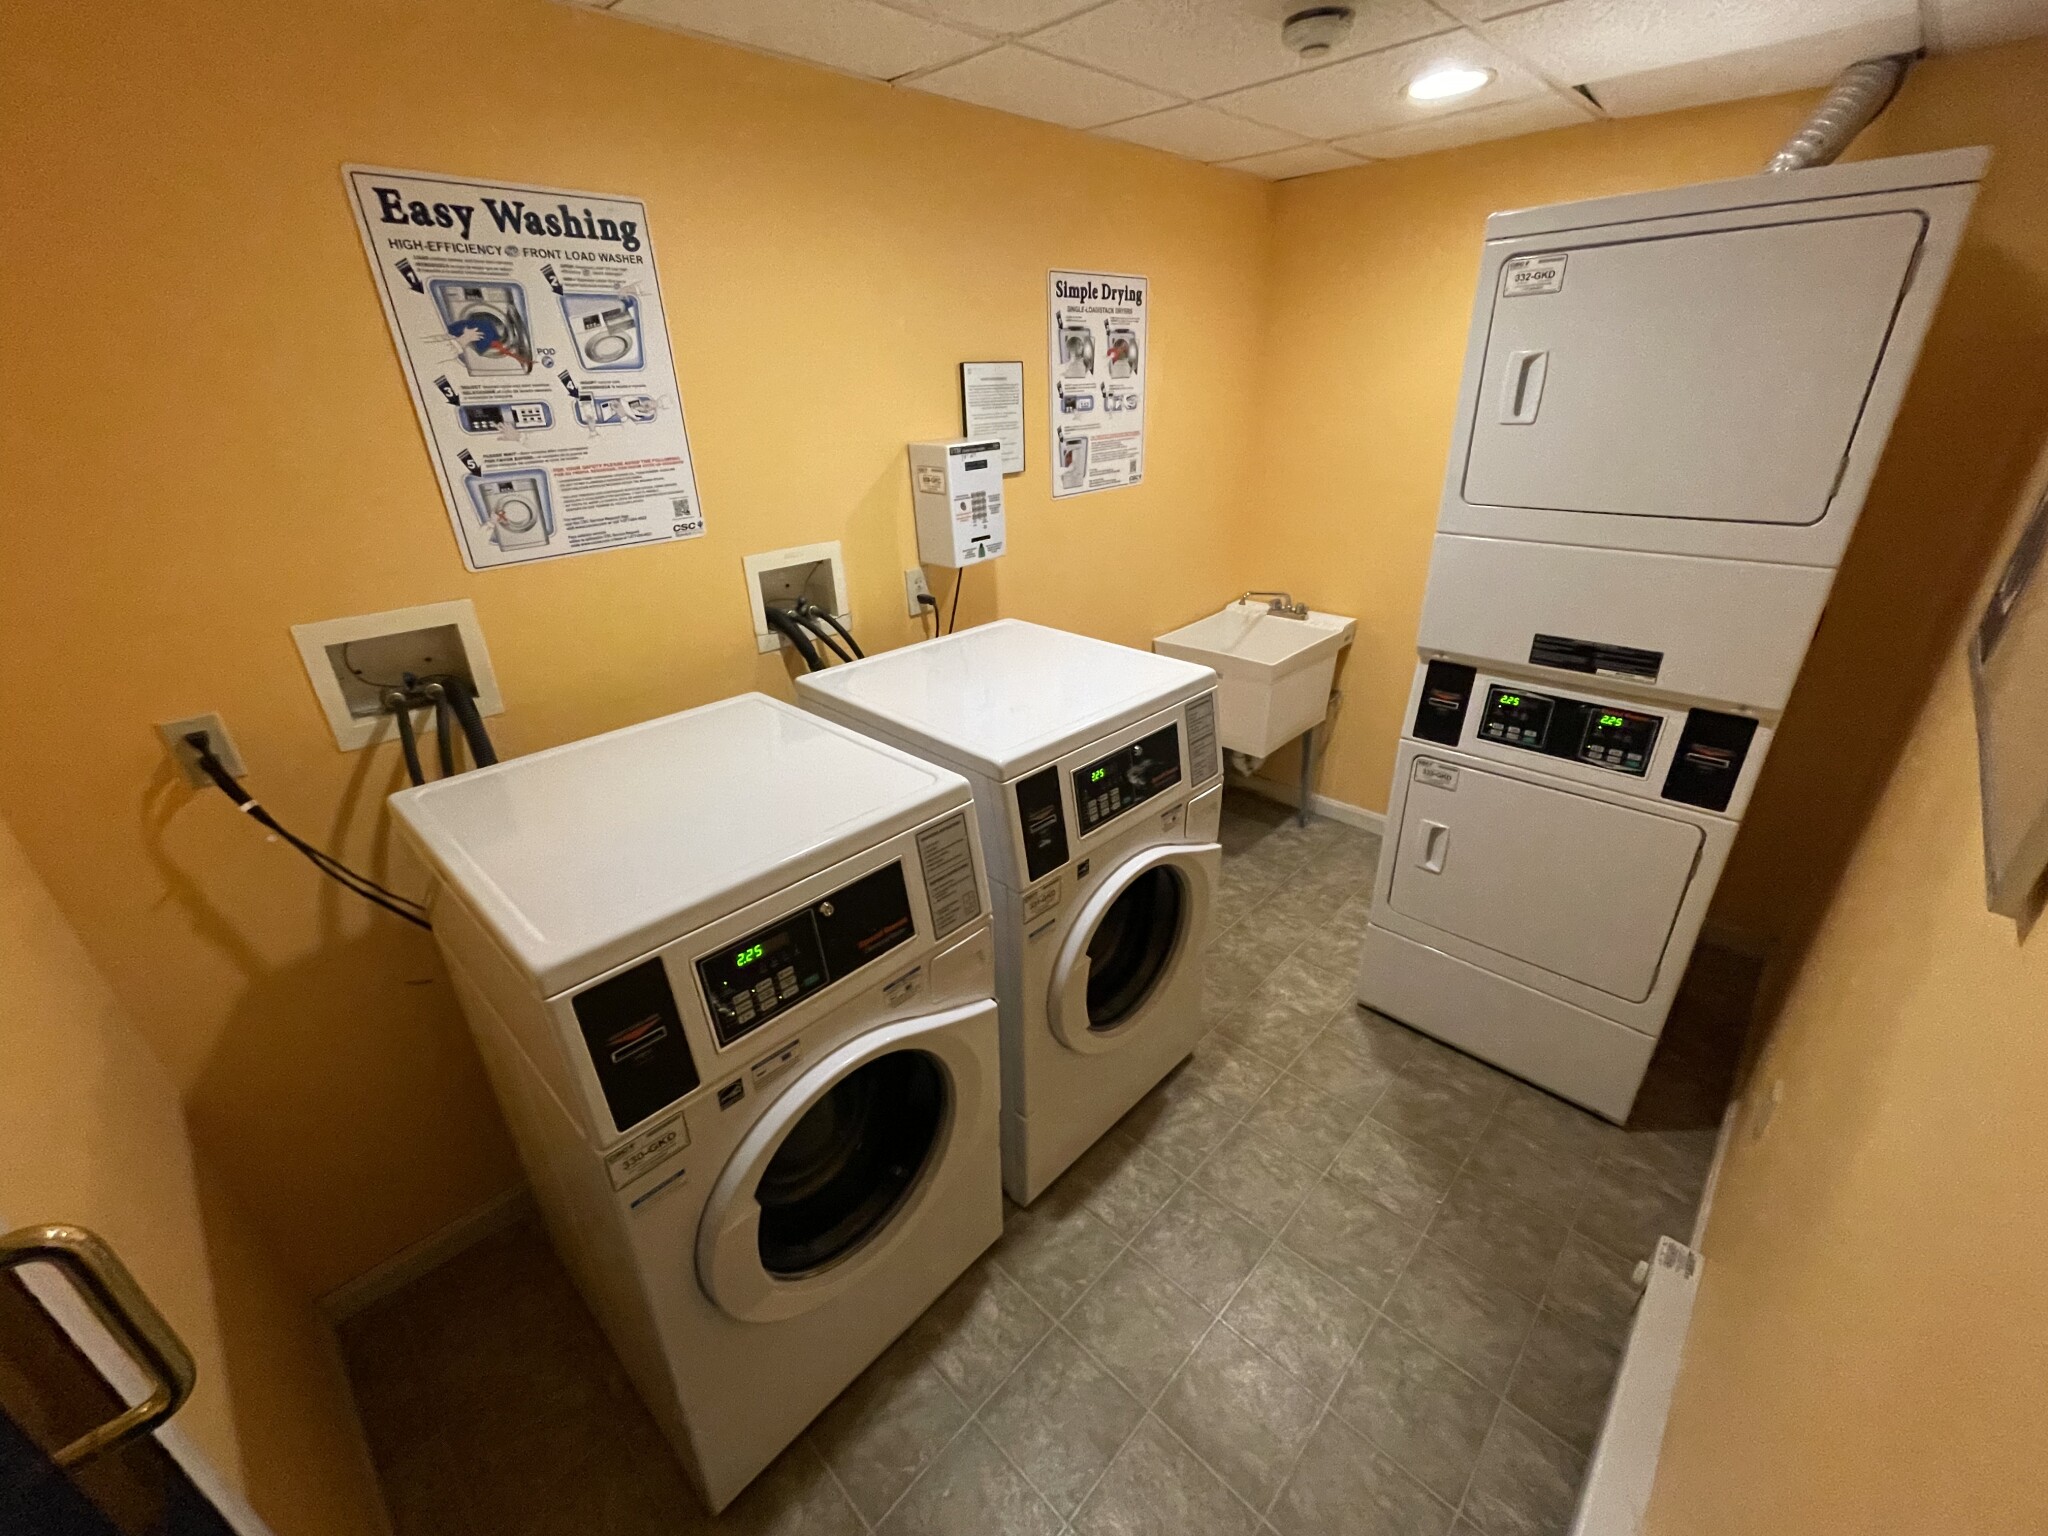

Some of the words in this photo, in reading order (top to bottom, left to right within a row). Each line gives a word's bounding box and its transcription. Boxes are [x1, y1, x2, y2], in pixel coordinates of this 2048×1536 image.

[371, 186, 475, 240] Easy
[480, 197, 641, 252] Washing
[388, 238, 502, 256] HIGH-EFFICIENCY
[522, 247, 562, 260] FRONT
[564, 250, 597, 262] LOAD
[598, 252, 643, 265] WASHER
[549, 275, 558, 286] 2
[1514, 270, 1556, 282] 332-GKD
[1055, 279, 1098, 304] Simple
[1101, 283, 1143, 307] Drying
[536, 347, 556, 356] POD
[443, 386, 454, 398] 3
[466, 459, 476, 469] 5
[672, 522, 696, 532] CSC
[736, 944, 763, 967] 2.25
